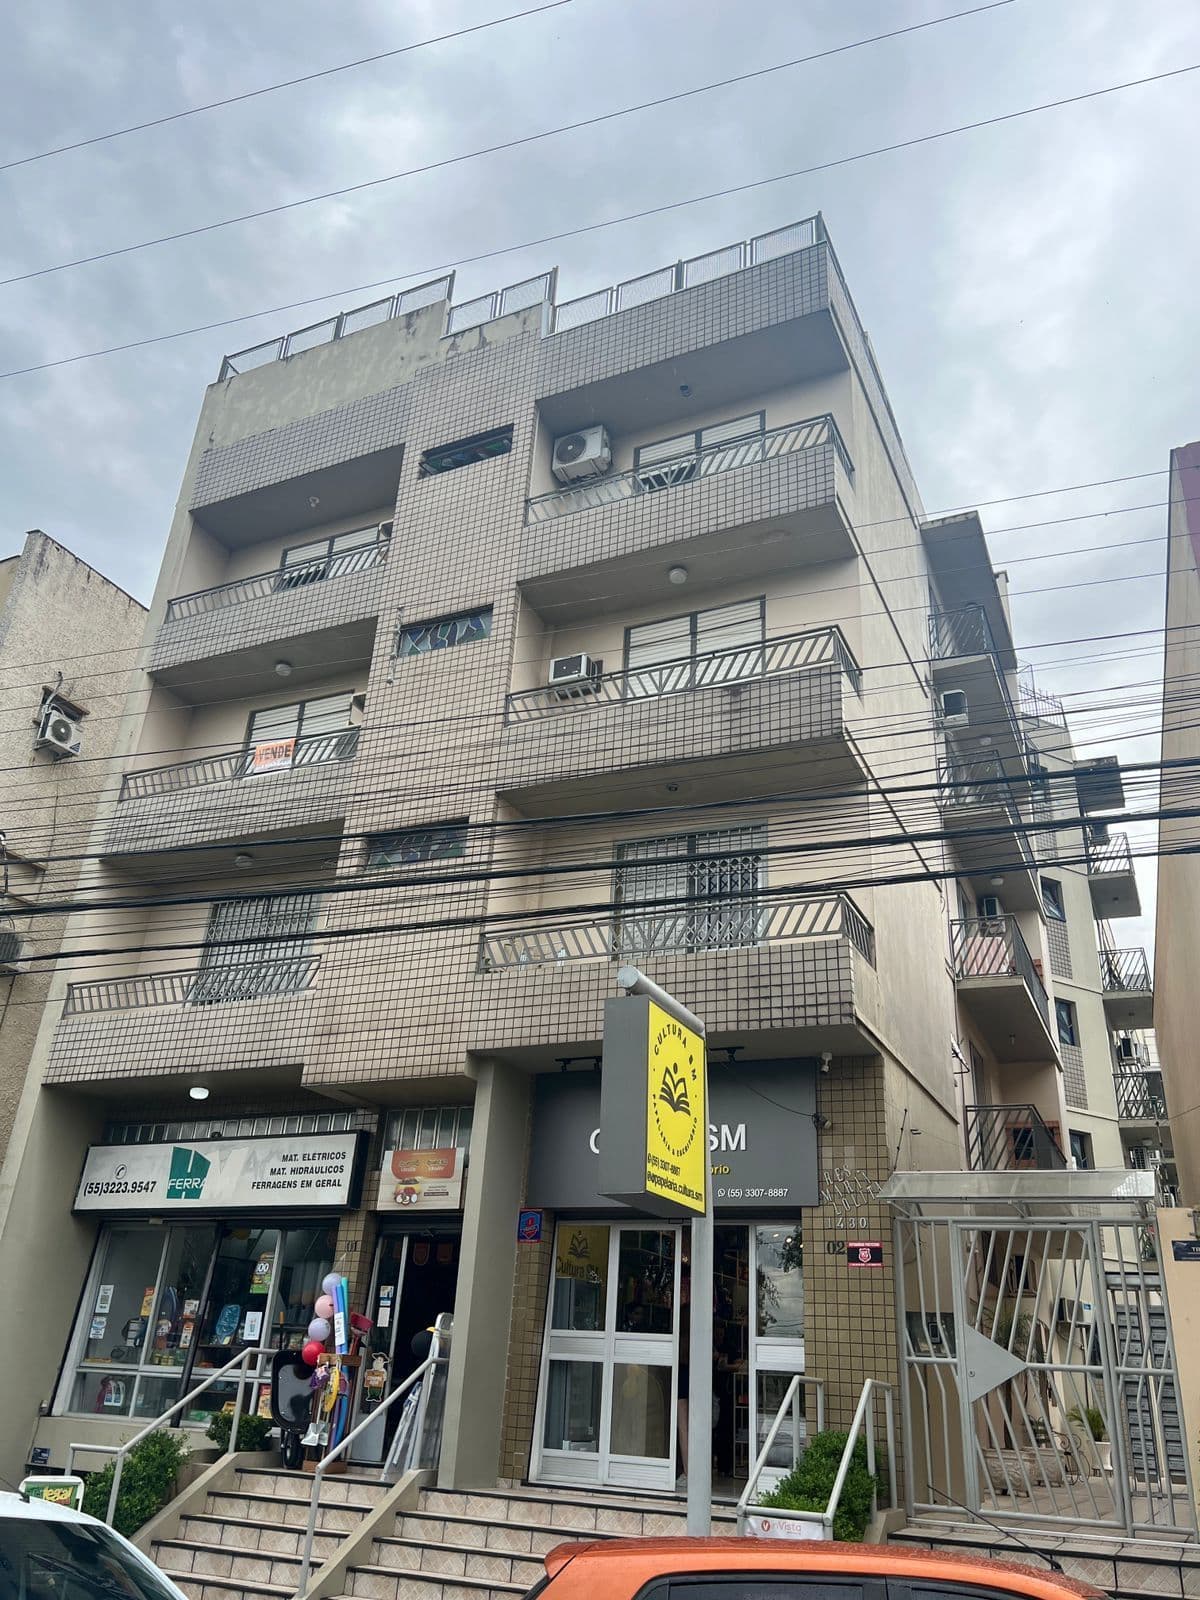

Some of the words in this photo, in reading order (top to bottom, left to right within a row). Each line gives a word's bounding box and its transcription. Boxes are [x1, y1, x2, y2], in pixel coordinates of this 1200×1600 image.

[654, 1024, 687, 1056] CULTURA
[281, 1154, 299, 1163] MAT.
[270, 1167, 288, 1176] MAT.
[83, 1181, 157, 1197] (55)3223.9547
[252, 1180, 298, 1190] FERRAGENS
[300, 1180, 313, 1189] EM
[315, 1179, 342, 1188] GERAL
[727, 1187, 743, 1199] (55)
[744, 1186, 789, 1198] 3307-8887
[827, 1240, 847, 1255] 02
